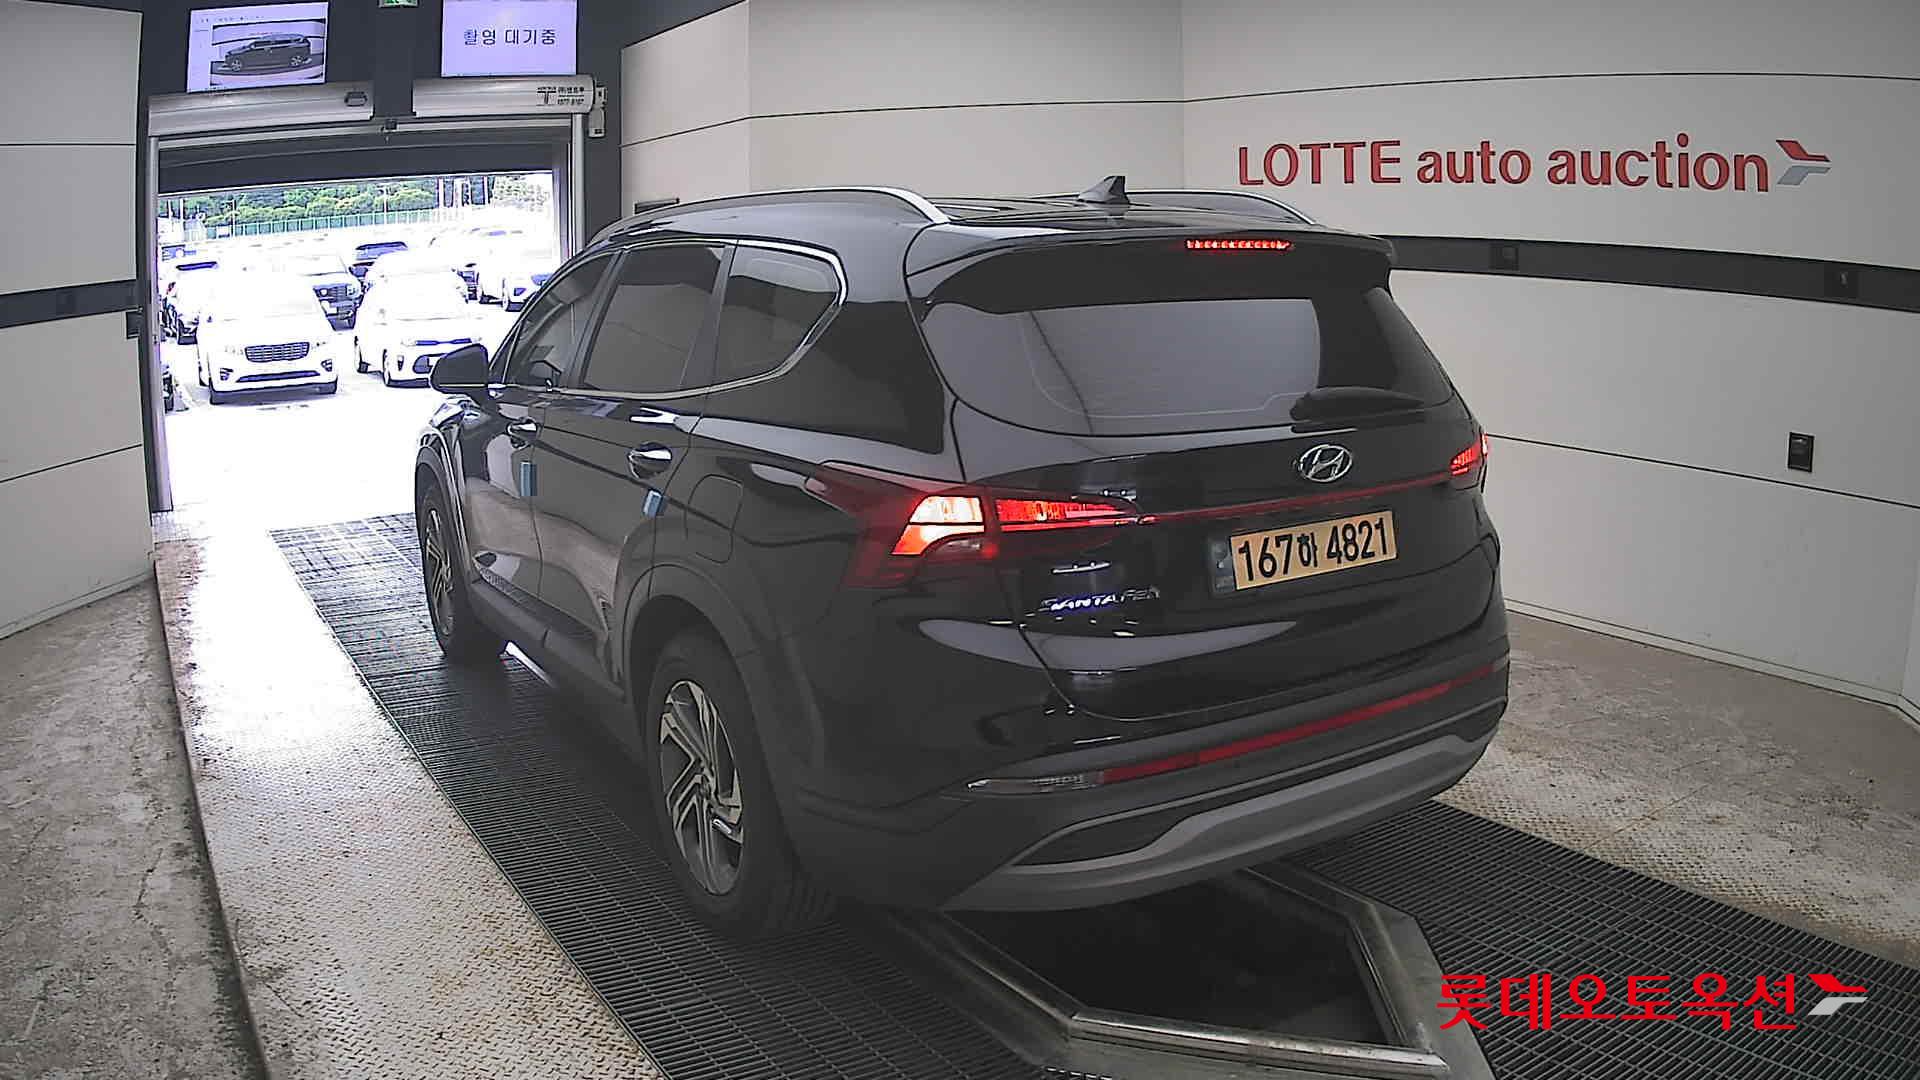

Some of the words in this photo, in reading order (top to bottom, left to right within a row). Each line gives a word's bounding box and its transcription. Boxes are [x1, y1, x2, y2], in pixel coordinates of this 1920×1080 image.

[504, 28, 556, 46] 대기중
[1238, 140, 1401, 186] LOTTE
[1416, 140, 1532, 185] auto
[1547, 132, 1769, 193] auction
[1238, 532, 1318, 582] 167하
[1327, 517, 1388, 565] 4821
